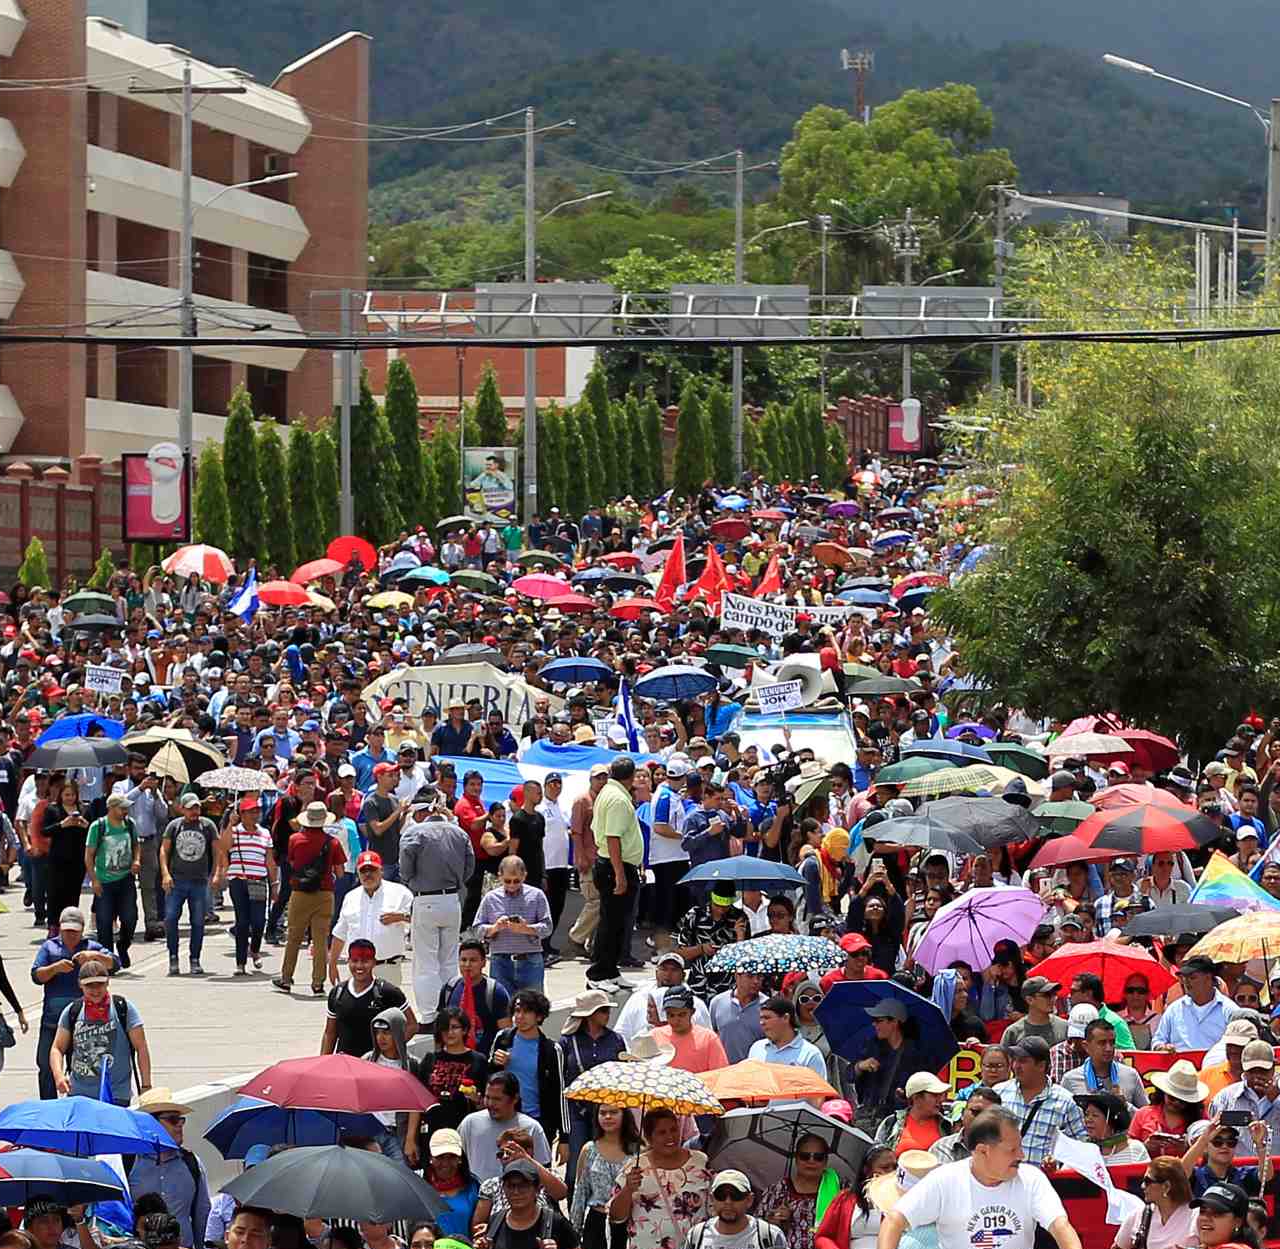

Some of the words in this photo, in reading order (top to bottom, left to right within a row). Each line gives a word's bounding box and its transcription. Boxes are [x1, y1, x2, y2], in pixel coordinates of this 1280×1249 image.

[724, 594, 745, 611] No
[981, 1205, 1023, 1231] GENERATION
[983, 1216, 1006, 1228] 019
